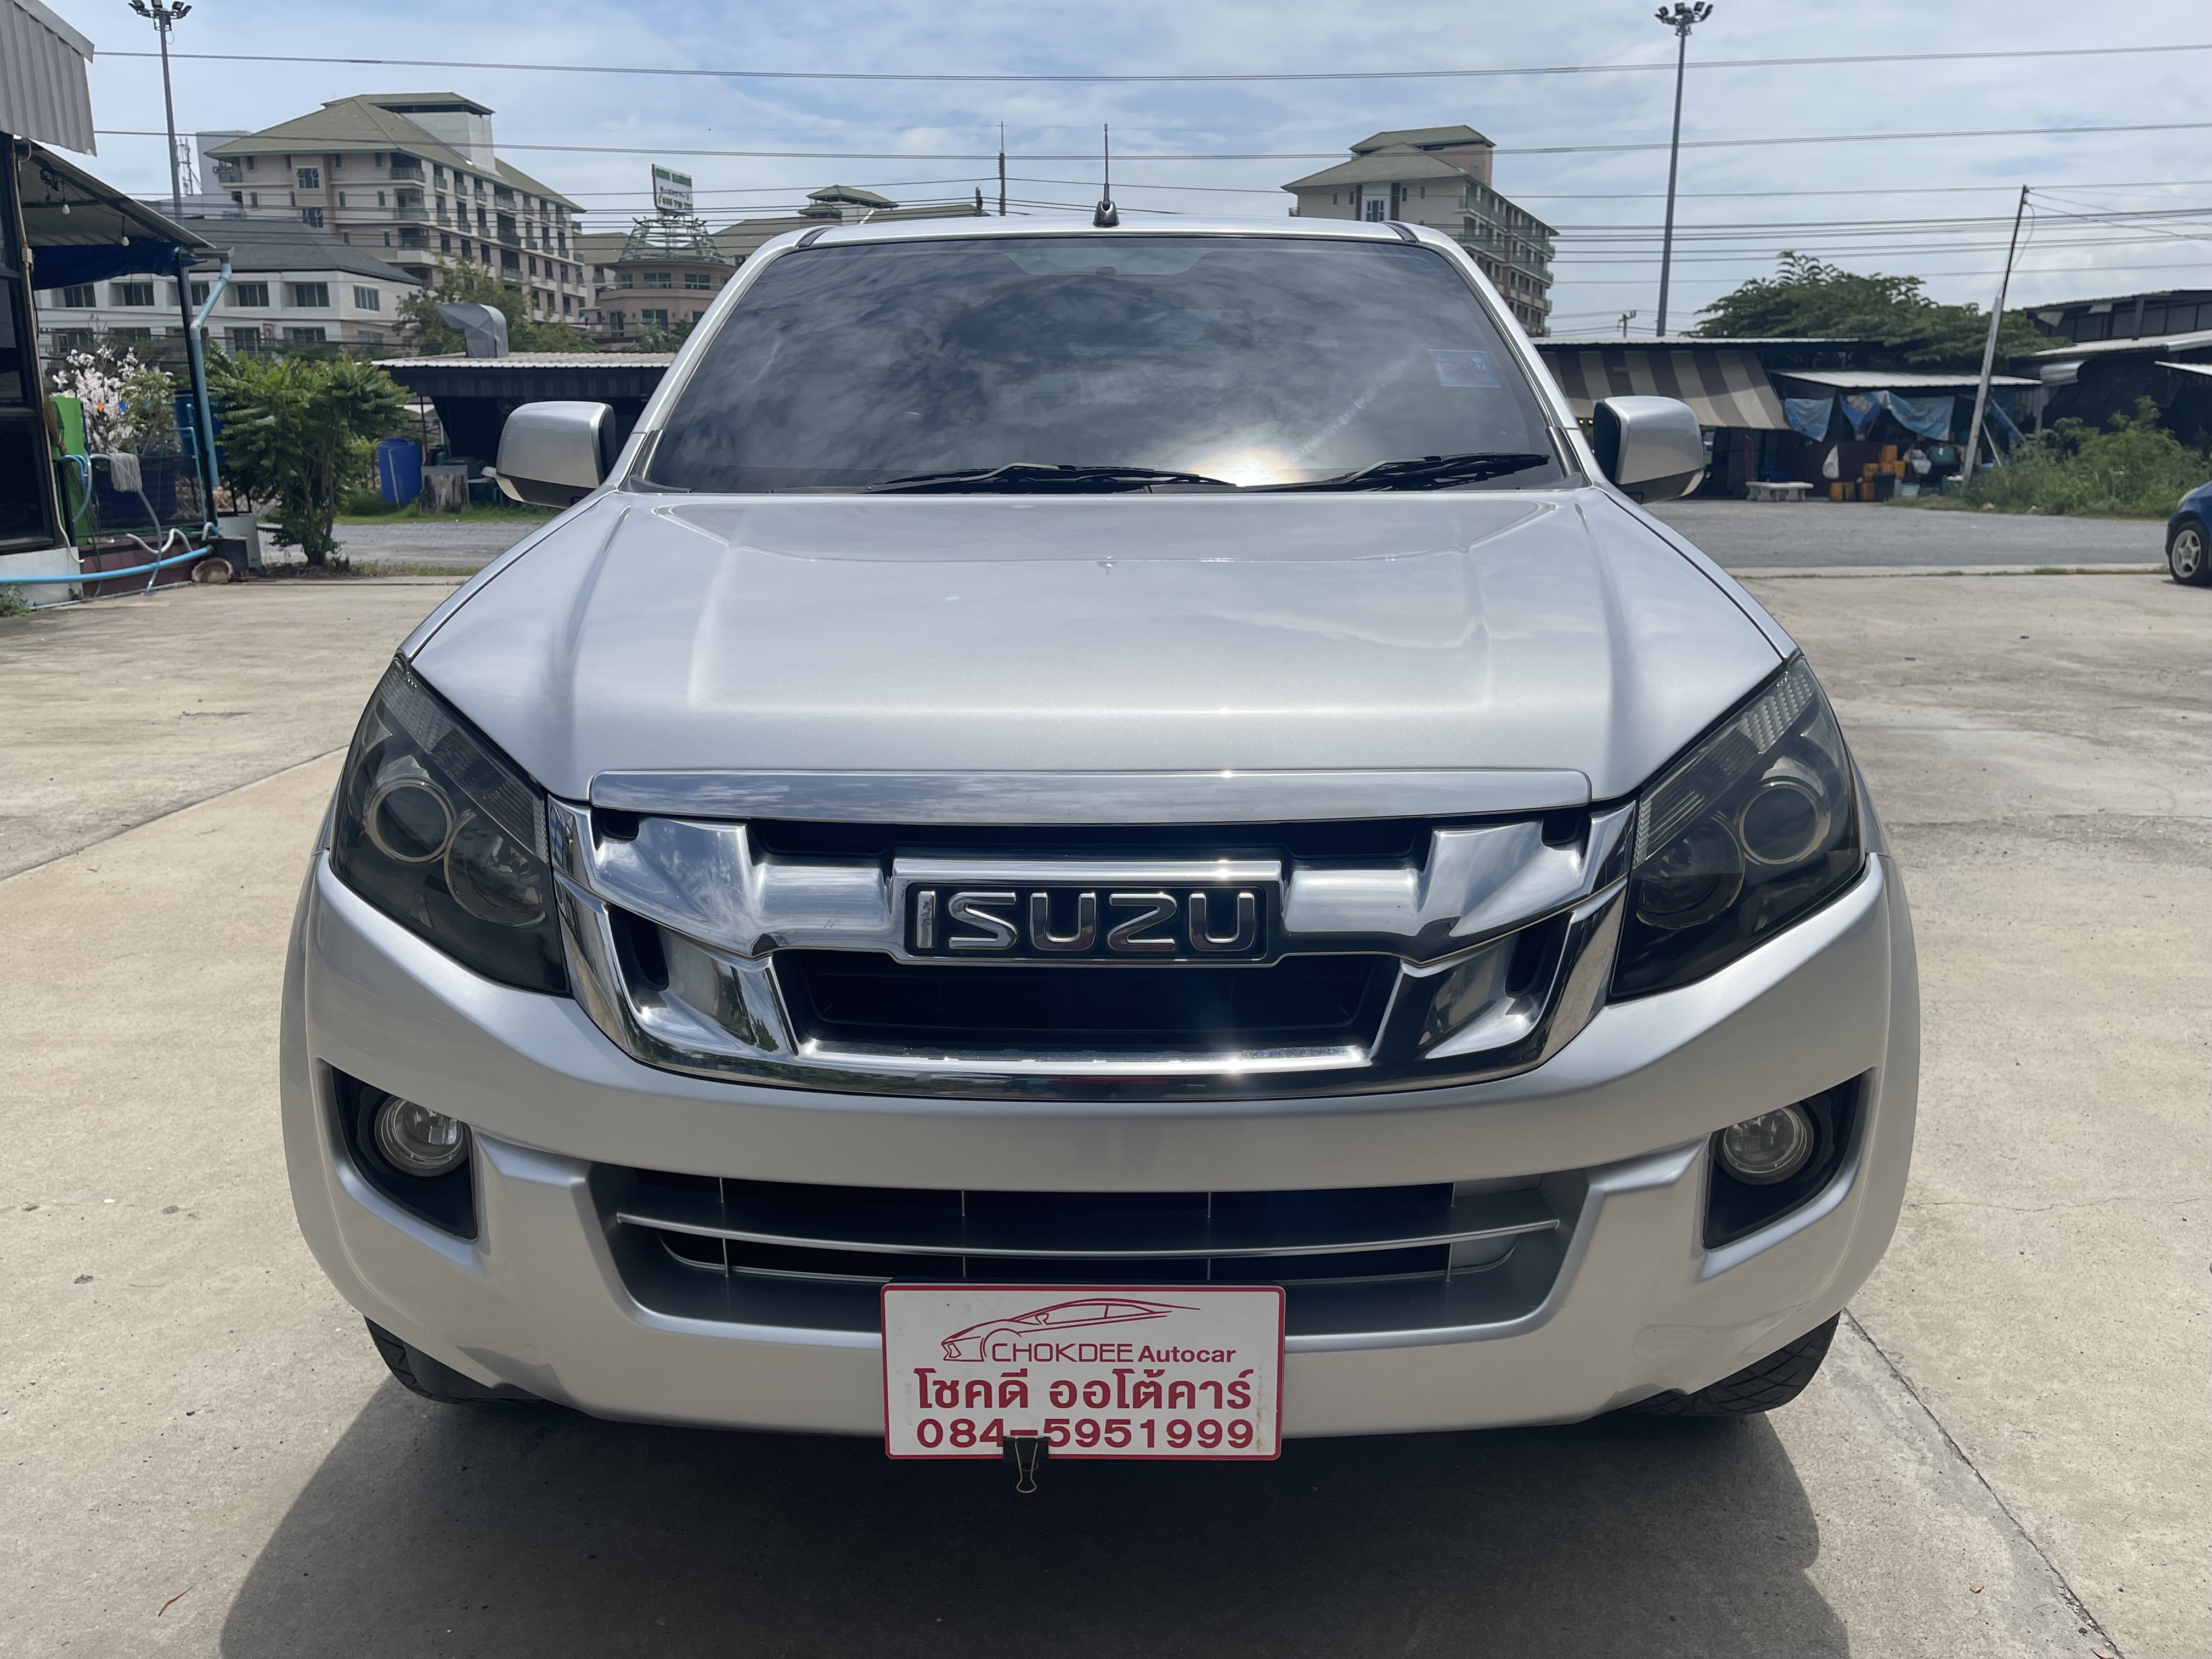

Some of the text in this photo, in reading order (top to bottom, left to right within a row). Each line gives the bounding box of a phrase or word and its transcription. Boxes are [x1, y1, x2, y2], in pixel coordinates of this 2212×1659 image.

[916, 890, 1255, 952] ISUZU
[992, 1343, 1236, 1363] CHOKDEE Autocar
[913, 1368, 1254, 1409] โชคดี ออโต้คาร์
[917, 1418, 1254, 1448] 084-5951999
